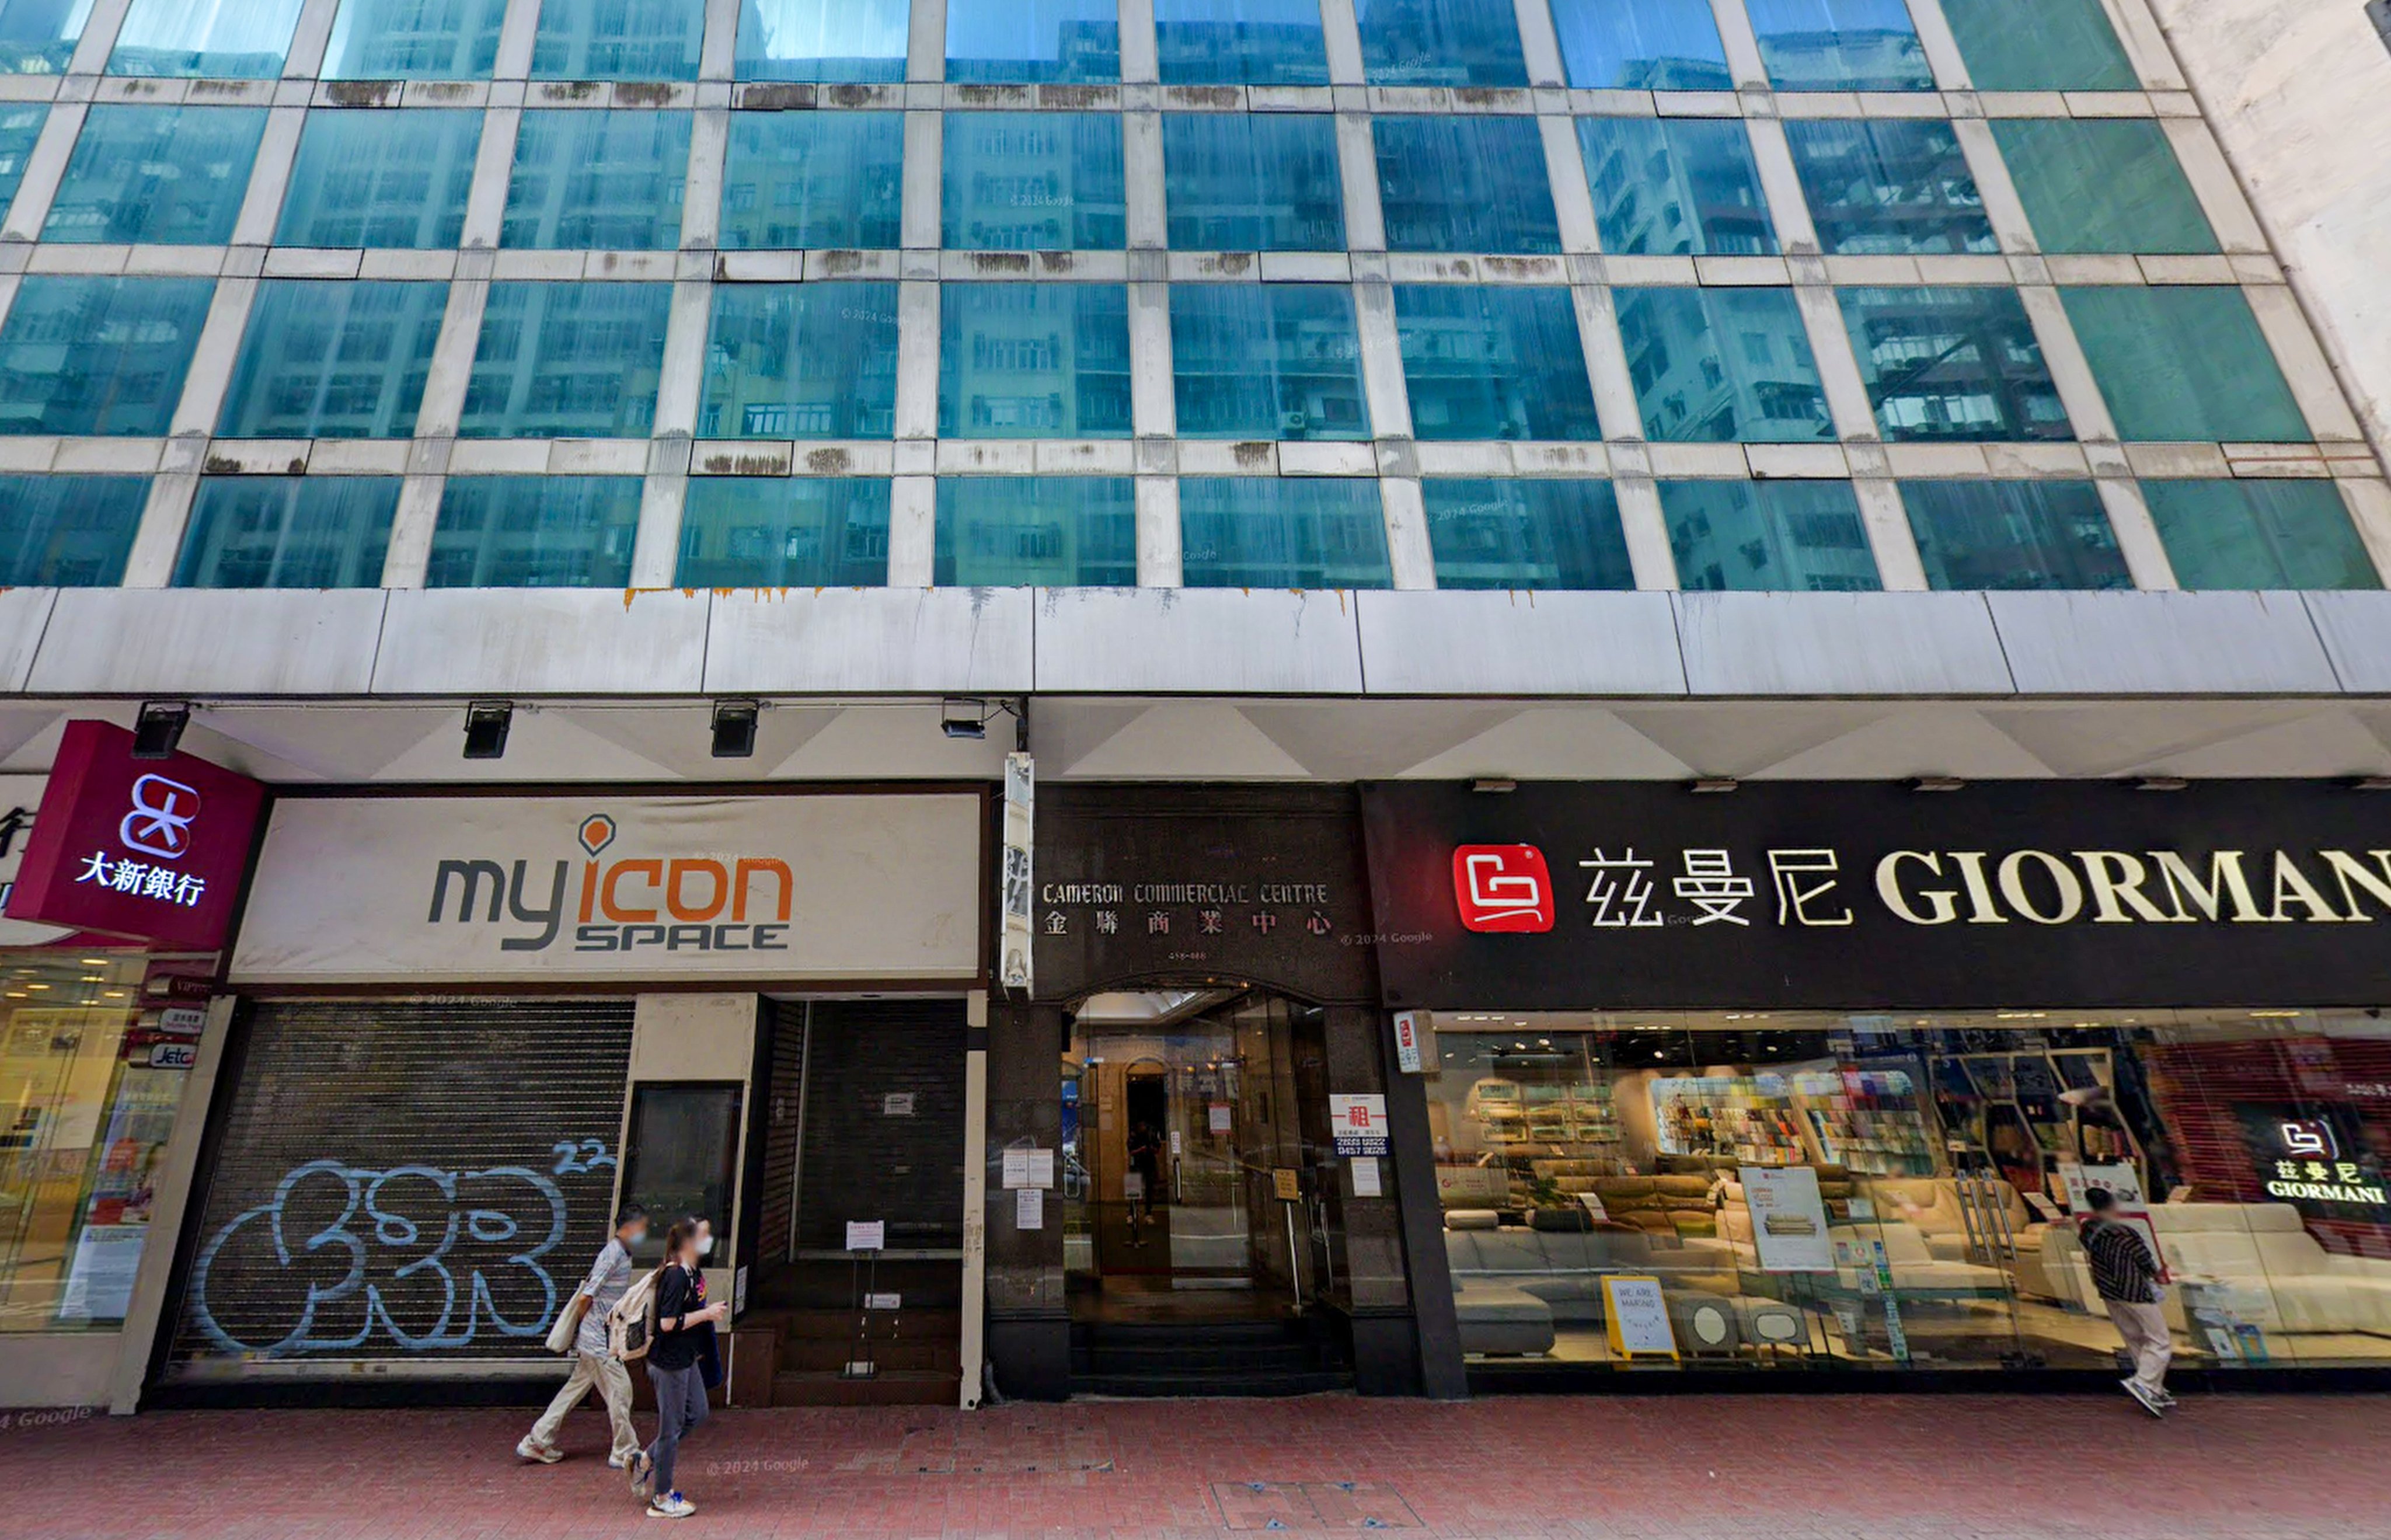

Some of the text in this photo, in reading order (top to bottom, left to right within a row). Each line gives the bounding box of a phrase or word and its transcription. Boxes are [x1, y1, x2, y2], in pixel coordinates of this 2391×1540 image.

[75, 851, 205, 907] 大新銀行
[1043, 883, 1329, 904] CAMERON COMMERCIAL CENTRE
[574, 924, 790, 952] SPACE
[1348, 1105, 1371, 1127] 租
[2267, 1180, 2387, 1204] GIORMANI
